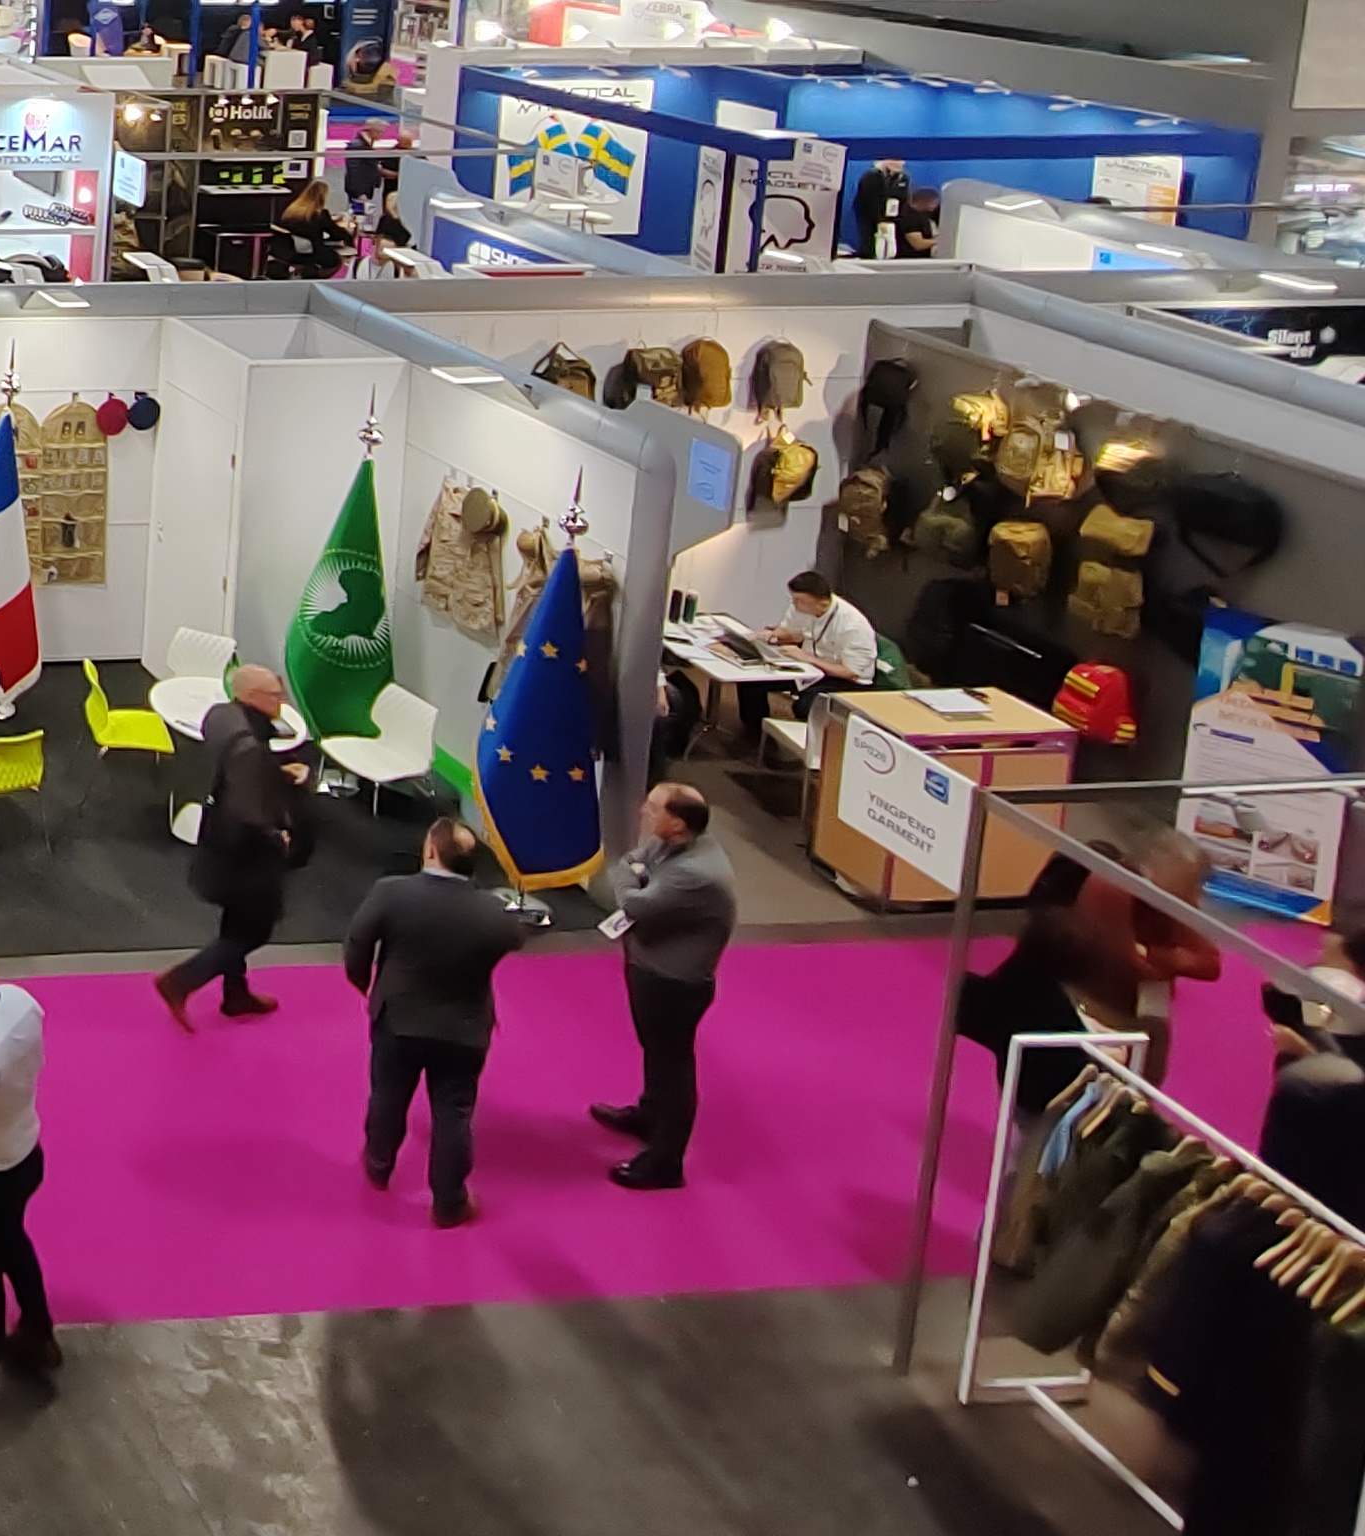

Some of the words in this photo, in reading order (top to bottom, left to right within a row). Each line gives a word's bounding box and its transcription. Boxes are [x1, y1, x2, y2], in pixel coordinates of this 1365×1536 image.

[230, 104, 274, 119] Holik
[867, 791, 937, 840] YINGPENG
[867, 808, 934, 854] GARMENT
